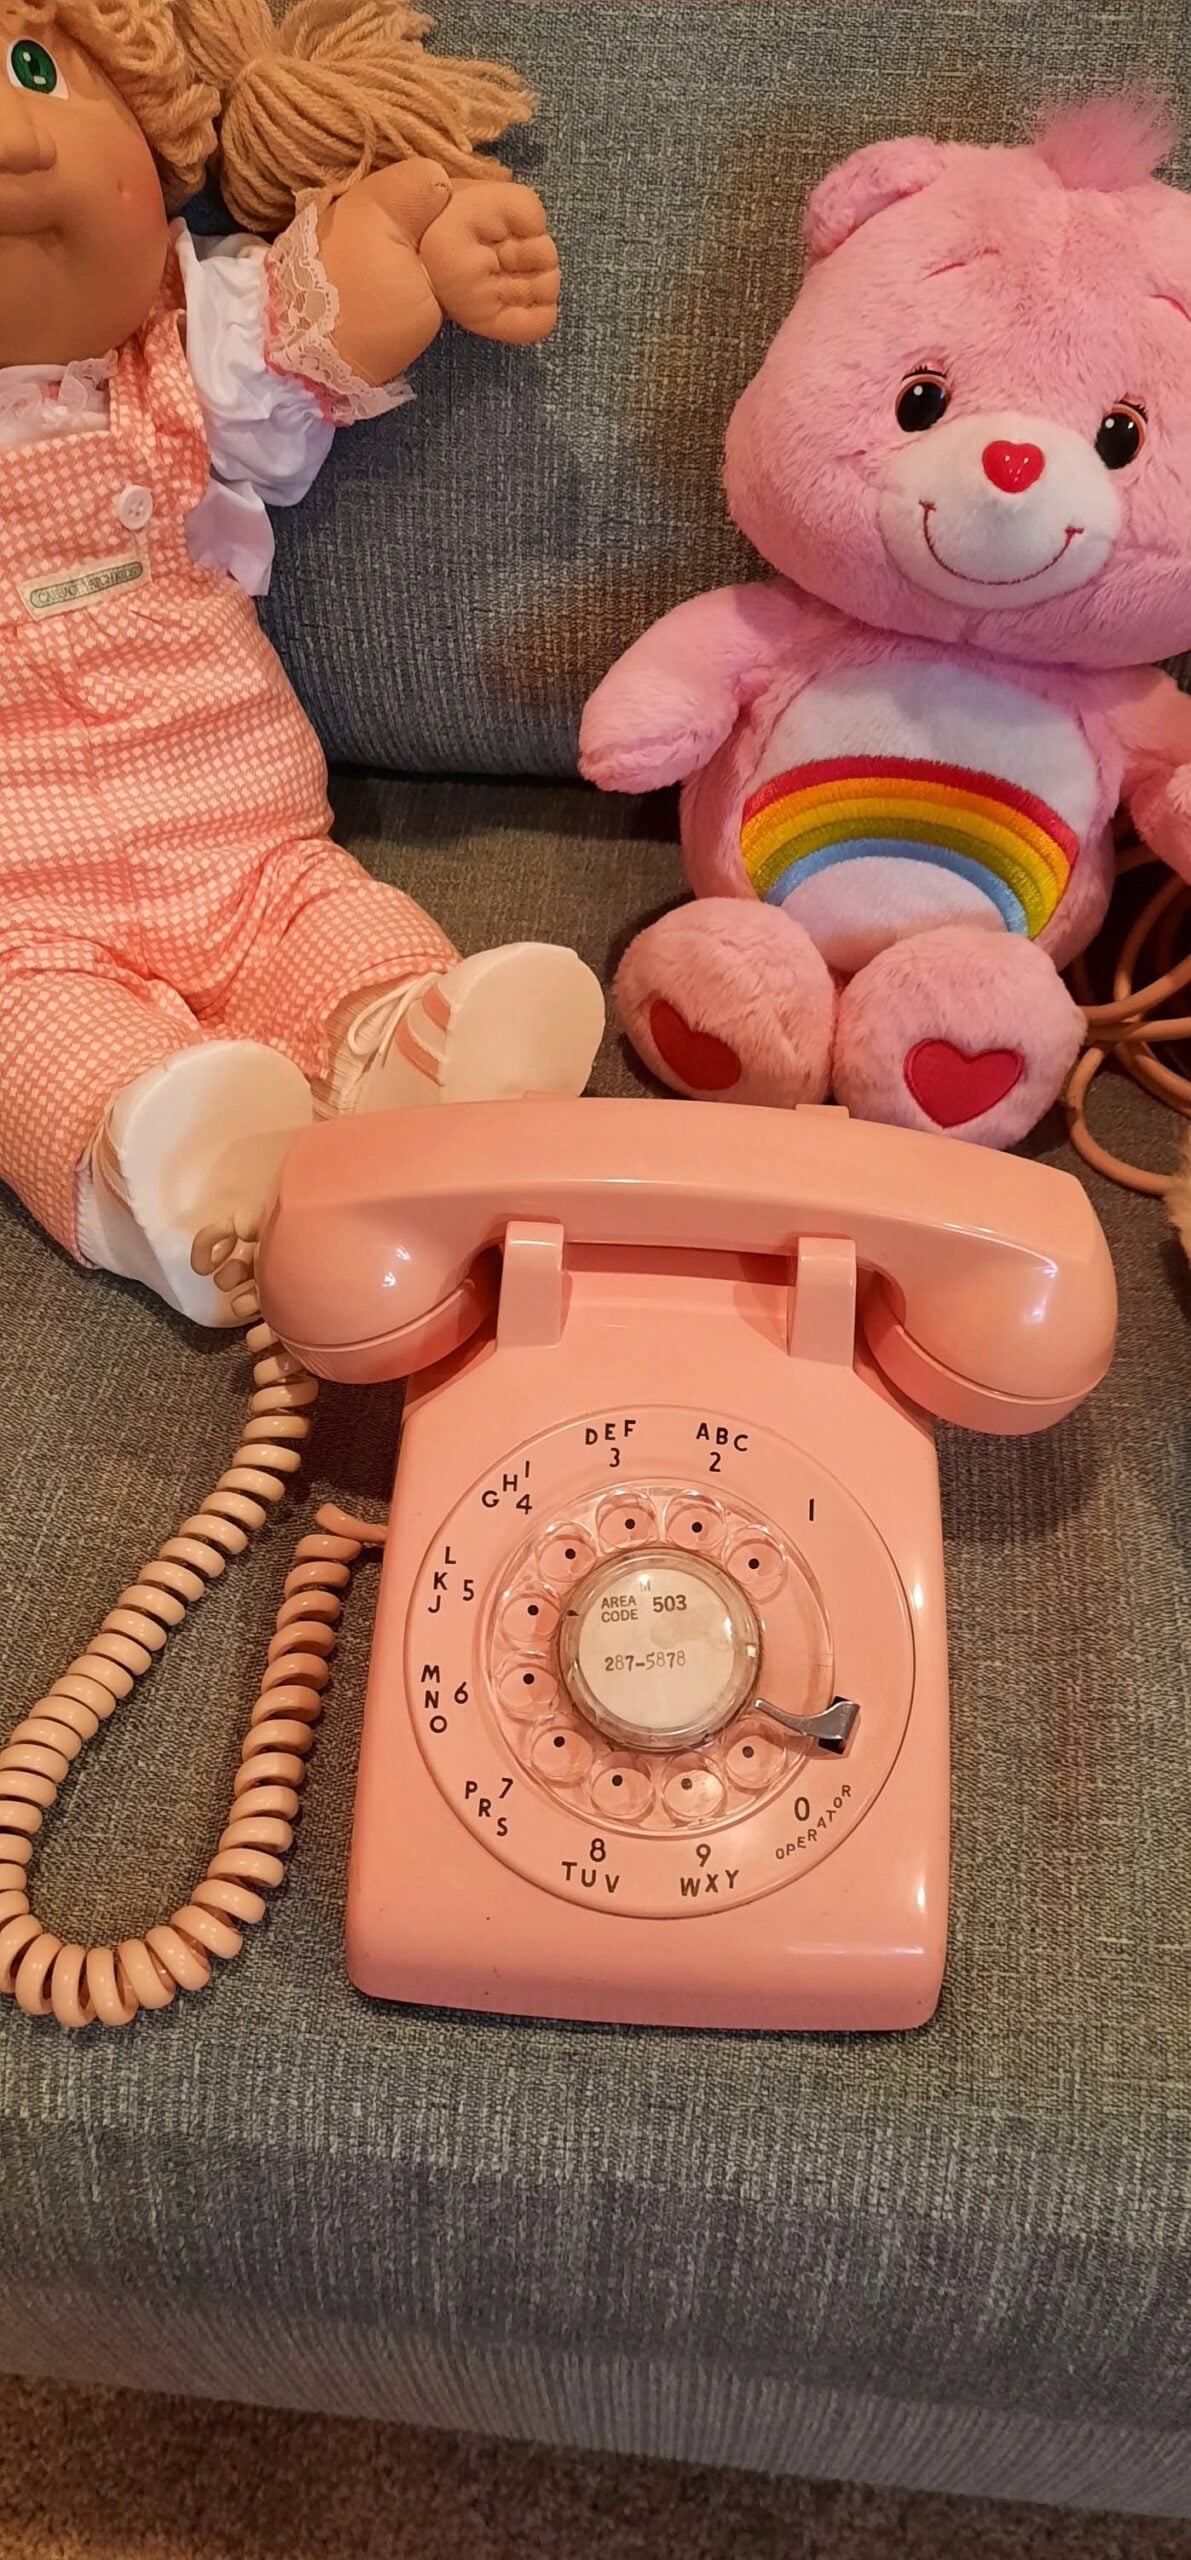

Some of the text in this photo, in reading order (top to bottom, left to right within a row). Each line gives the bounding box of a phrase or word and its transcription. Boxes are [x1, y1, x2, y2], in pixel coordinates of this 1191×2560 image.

[585, 1419, 637, 1446] DEF
[695, 1422, 749, 1452] ABC
[609, 1447, 621, 1468] 3
[708, 1451, 721, 1473] 2
[515, 1493, 533, 1515] 4
[462, 1579, 475, 1602] 5
[600, 1594, 688, 1613] AREA 503
[600, 1609, 640, 1623] CODE
[604, 1650, 687, 1672] 287-5878
[453, 1681, 469, 1705] 6
[498, 1777, 514, 1799] 7
[775, 1783, 852, 1860] OPERATOR
[589, 1837, 607, 1863] 8
[695, 1843, 712, 1868] 9
[561, 1861, 620, 1894] TUV
[679, 1869, 740, 1898] WXY
